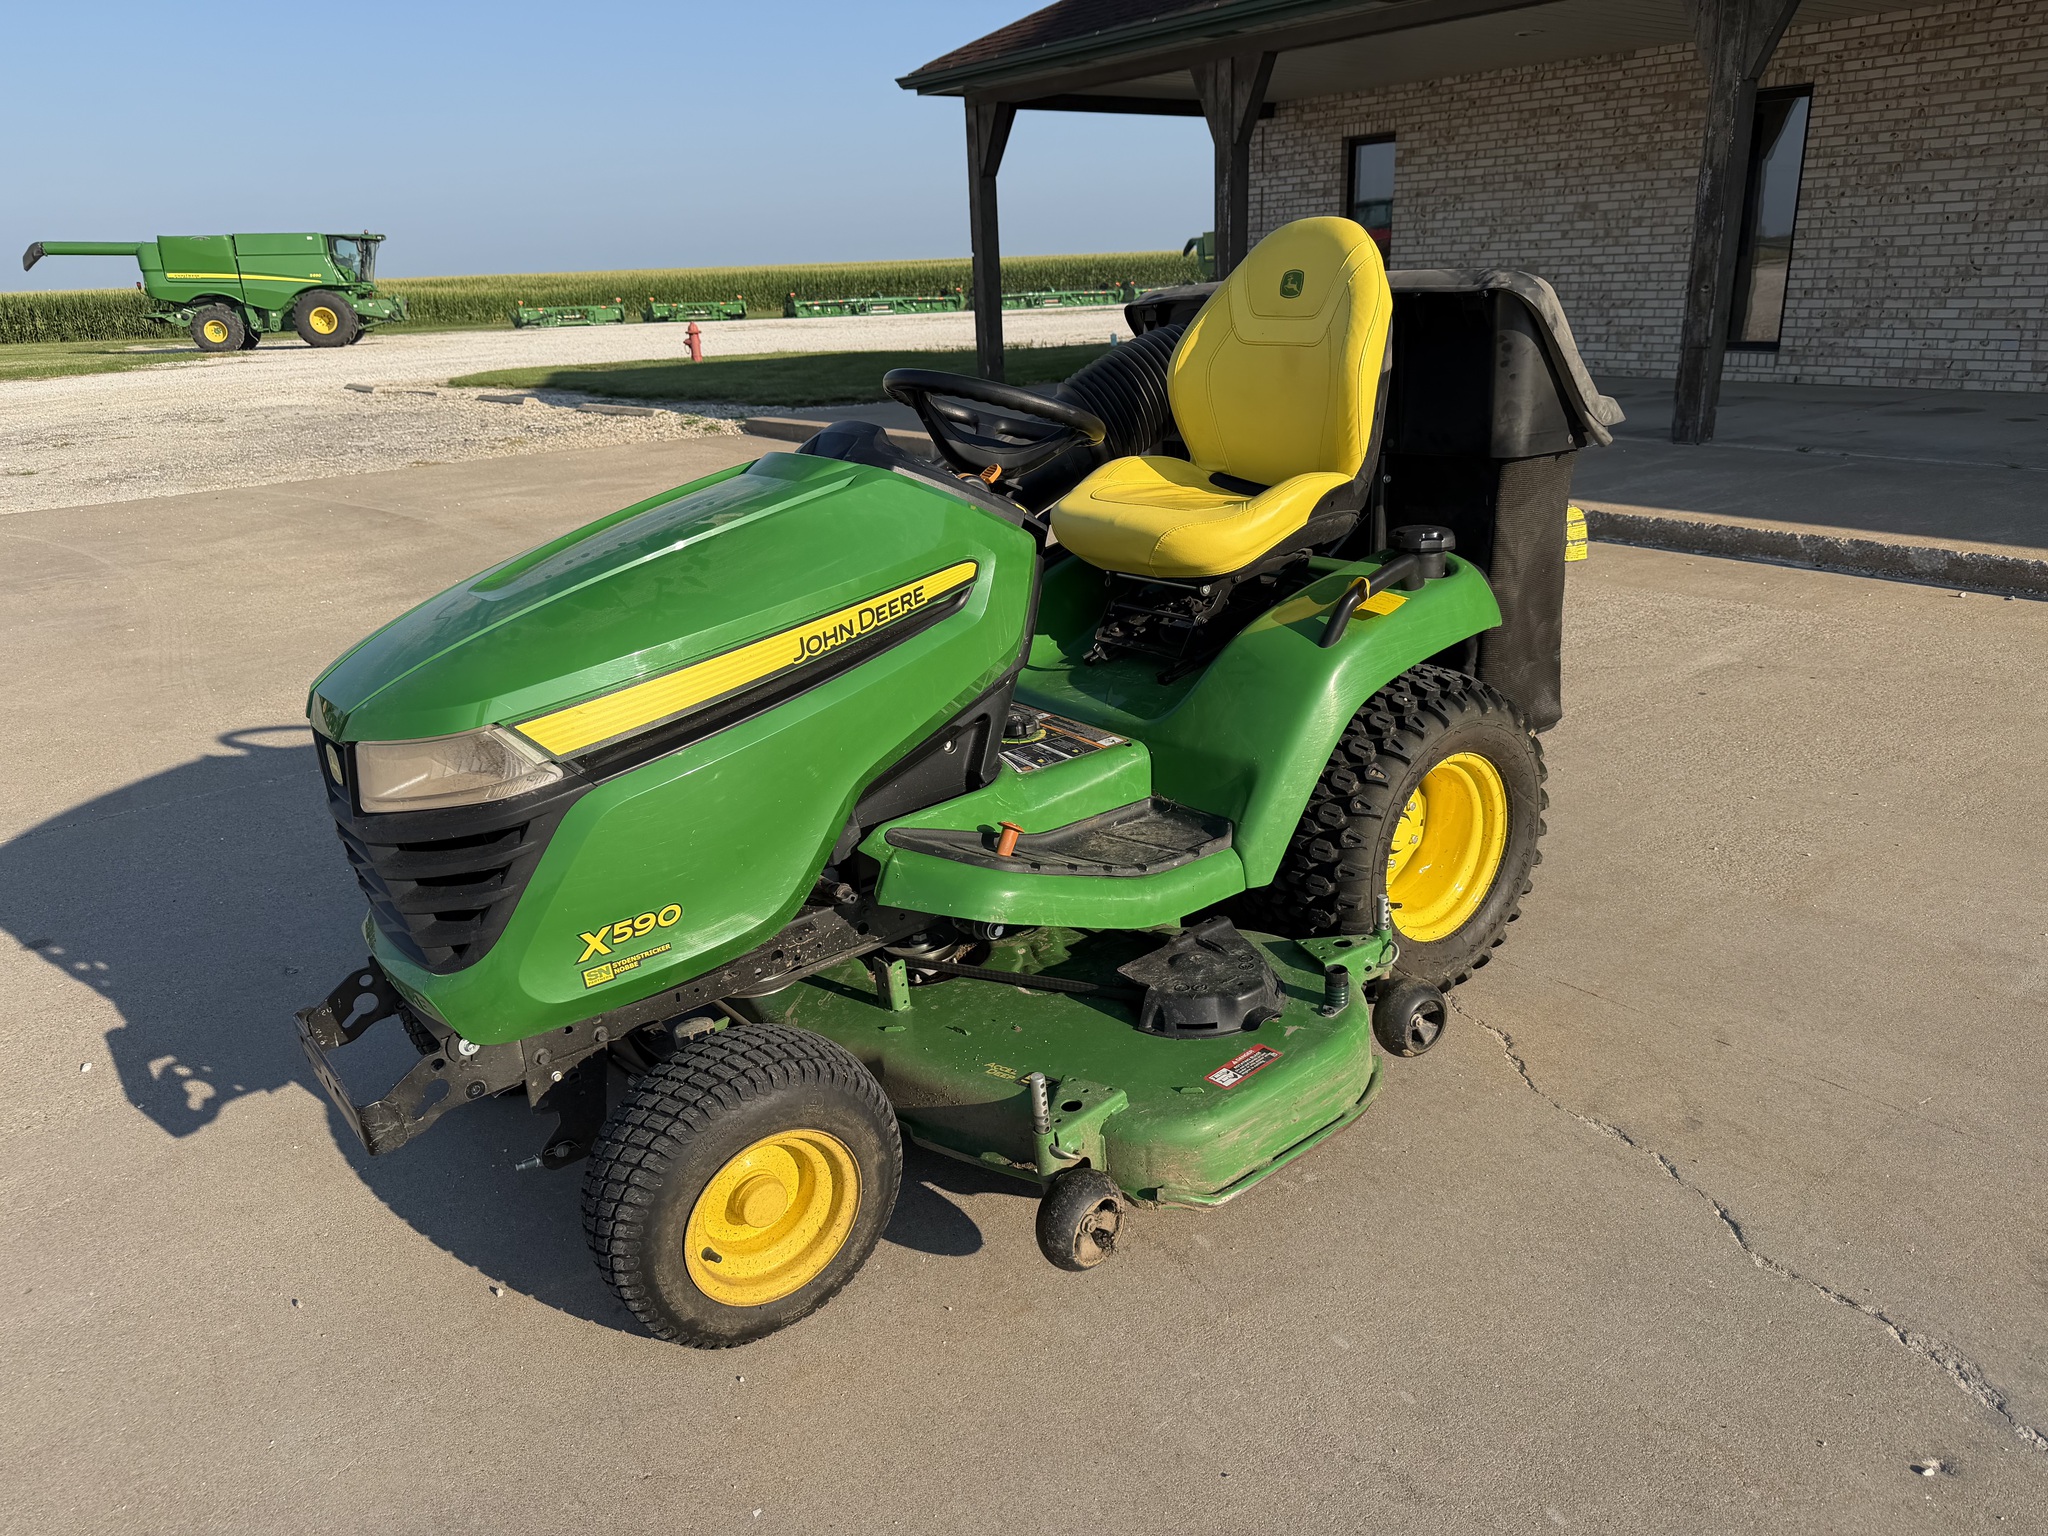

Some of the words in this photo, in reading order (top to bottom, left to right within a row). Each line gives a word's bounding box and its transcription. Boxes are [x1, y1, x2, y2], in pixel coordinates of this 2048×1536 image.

[793, 618, 855, 662] JOHN
[858, 585, 927, 631] DEERE
[576, 903, 682, 964] X590
[612, 944, 671, 968] SYDENSTRICKER
[586, 966, 611, 981] SN
[614, 961, 639, 975] NOBBE
[985, 1068, 1016, 1080] DEEP
